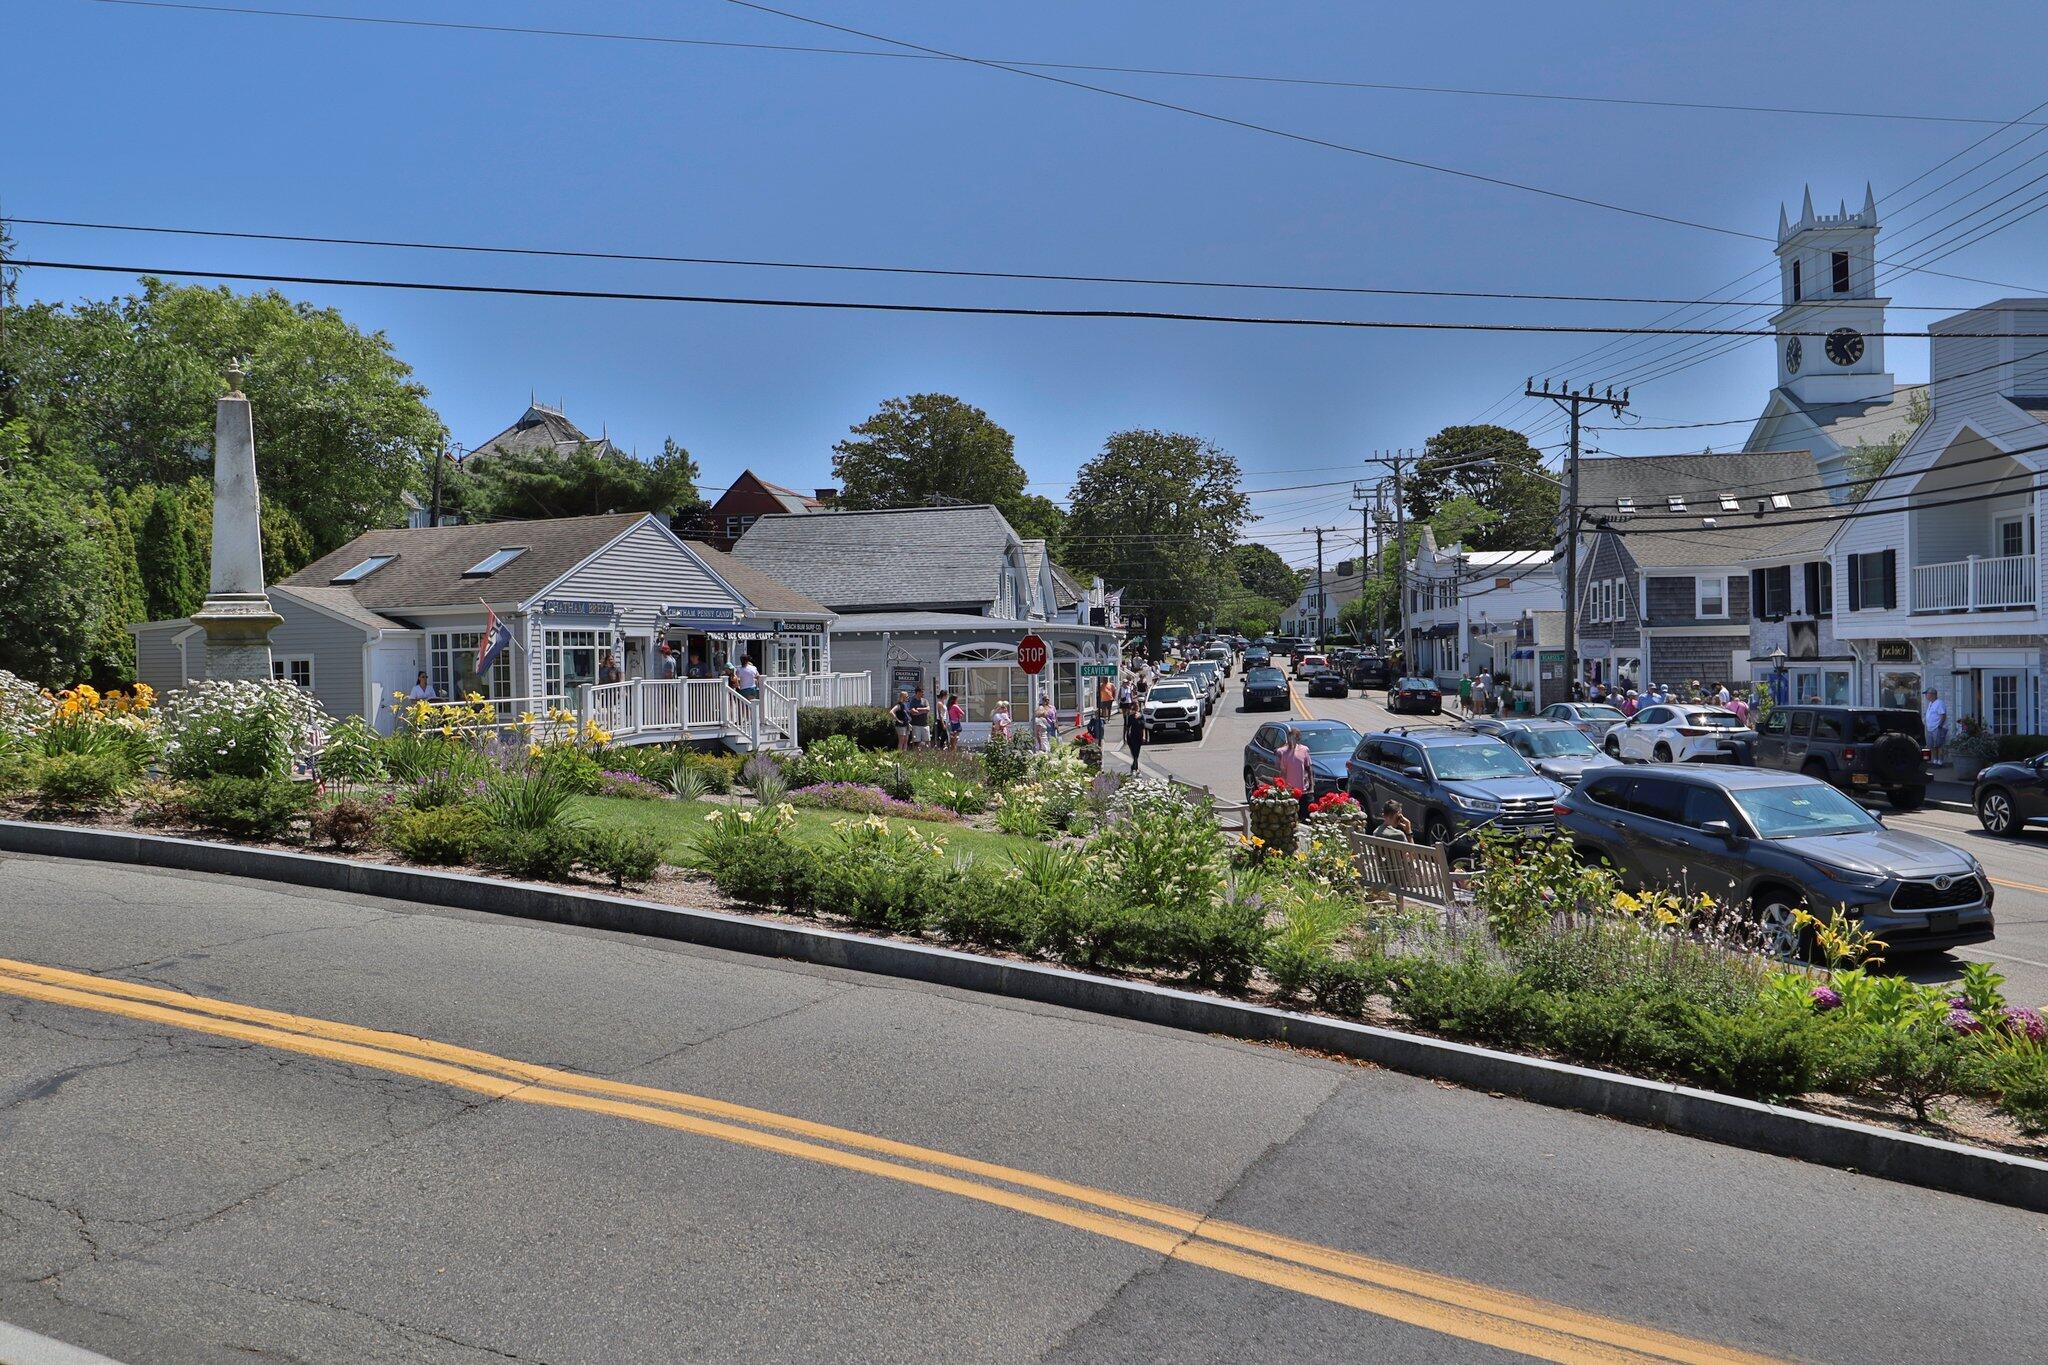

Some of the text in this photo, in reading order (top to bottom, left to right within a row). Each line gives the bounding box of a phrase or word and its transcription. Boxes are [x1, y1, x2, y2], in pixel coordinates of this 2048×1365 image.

[548, 601, 613, 614] CHATHAM BREEZE
[697, 609, 714, 618] PENNY
[715, 610, 733, 618] CANDY
[738, 632, 757, 640] CREAM
[1019, 647, 1044, 662] STOP
[1083, 666, 1110, 675] SEAVIEW
